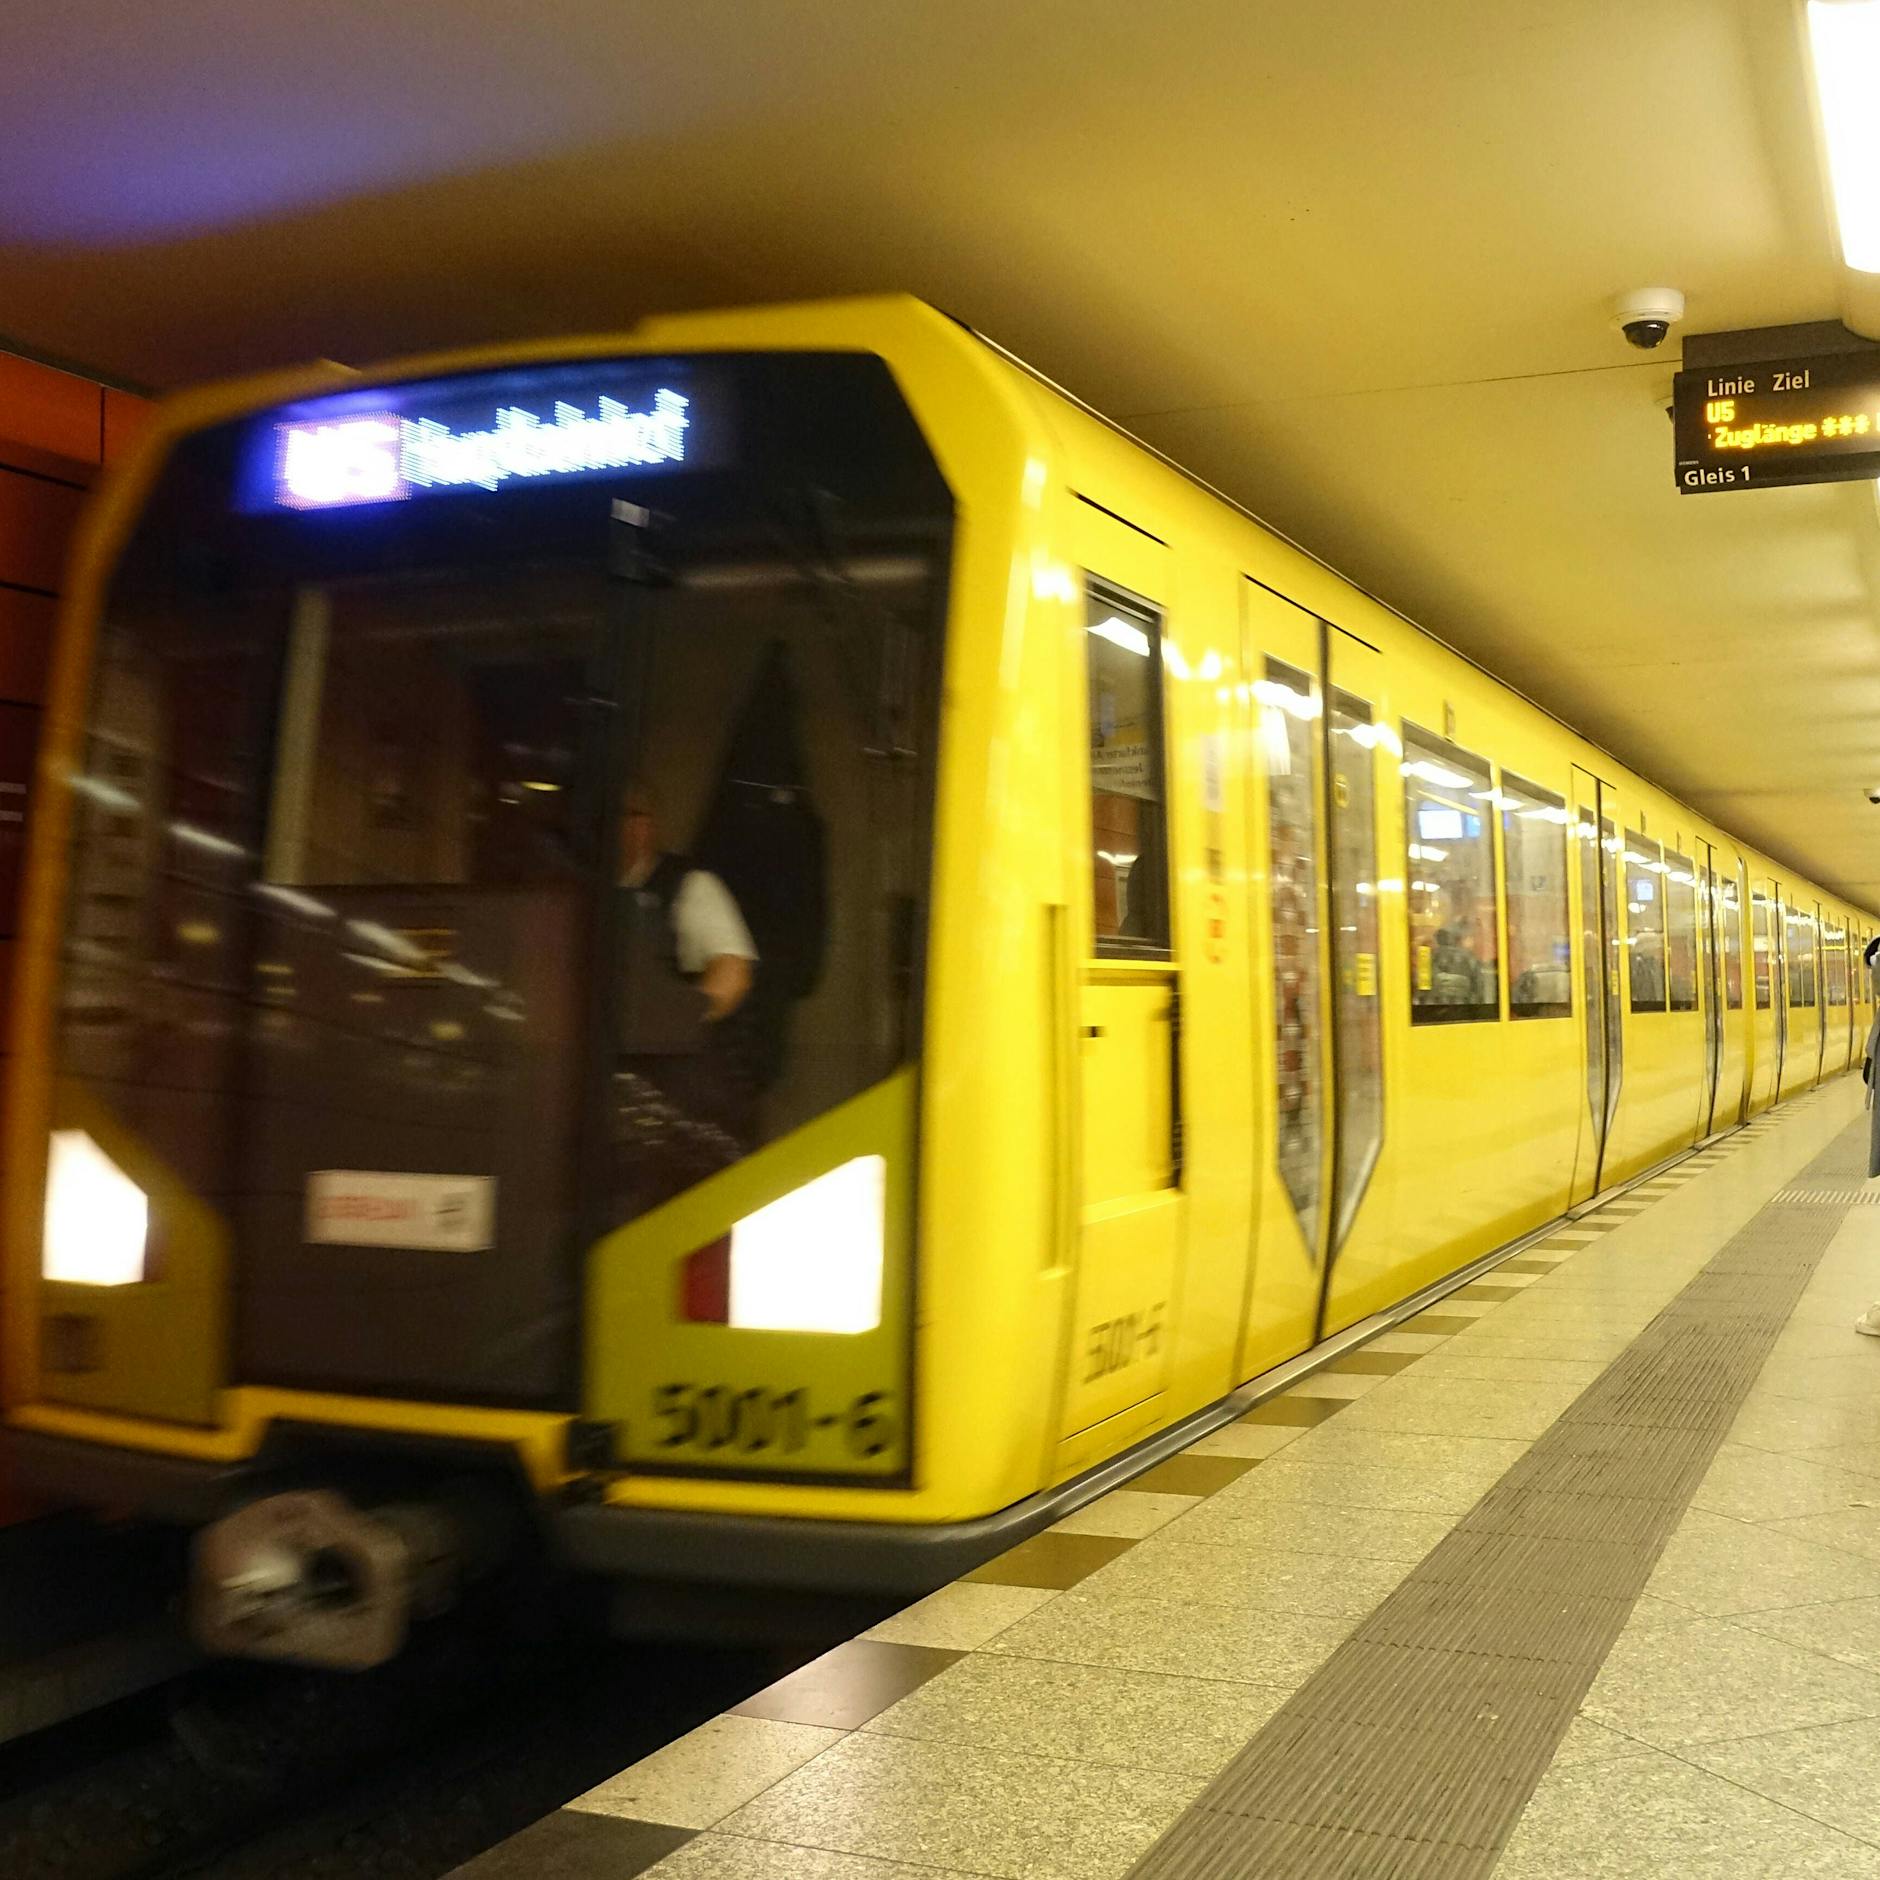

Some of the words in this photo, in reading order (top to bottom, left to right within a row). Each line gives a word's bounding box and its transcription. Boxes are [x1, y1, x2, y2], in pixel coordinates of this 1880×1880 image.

[1707, 376, 1755, 397] Linie
[1773, 369, 1810, 391] Ziel
[1706, 400, 1735, 423] U5
[1714, 422, 1818, 449] Zuglänge
[1684, 467, 1736, 487] Gleis
[1741, 465, 1751, 481] 1
[654, 1383, 892, 1459] 5001-6
